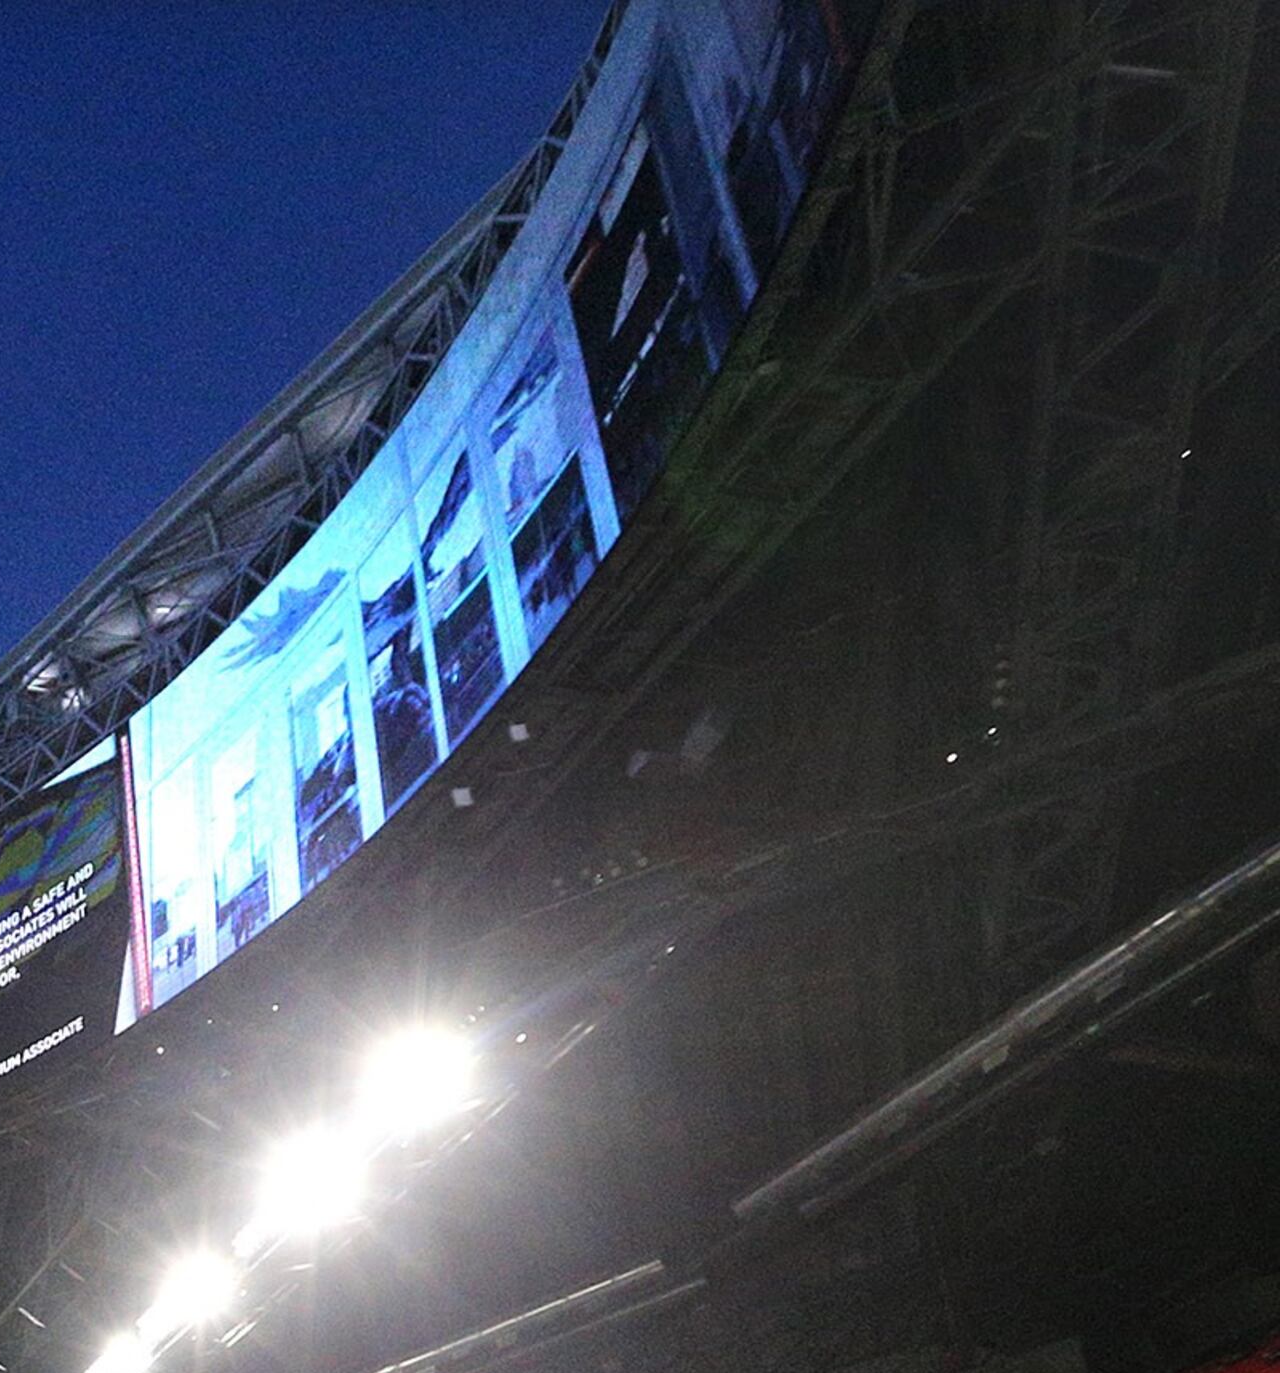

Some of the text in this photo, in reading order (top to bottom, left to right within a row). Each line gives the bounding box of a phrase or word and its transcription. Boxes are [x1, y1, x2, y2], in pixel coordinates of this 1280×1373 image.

[22, 906, 32, 920] A
[33, 881, 65, 912] SAFE
[67, 863, 94, 891] AND
[56, 887, 86, 915] WILL
[22, 1016, 84, 1063] ASSOCIATE
